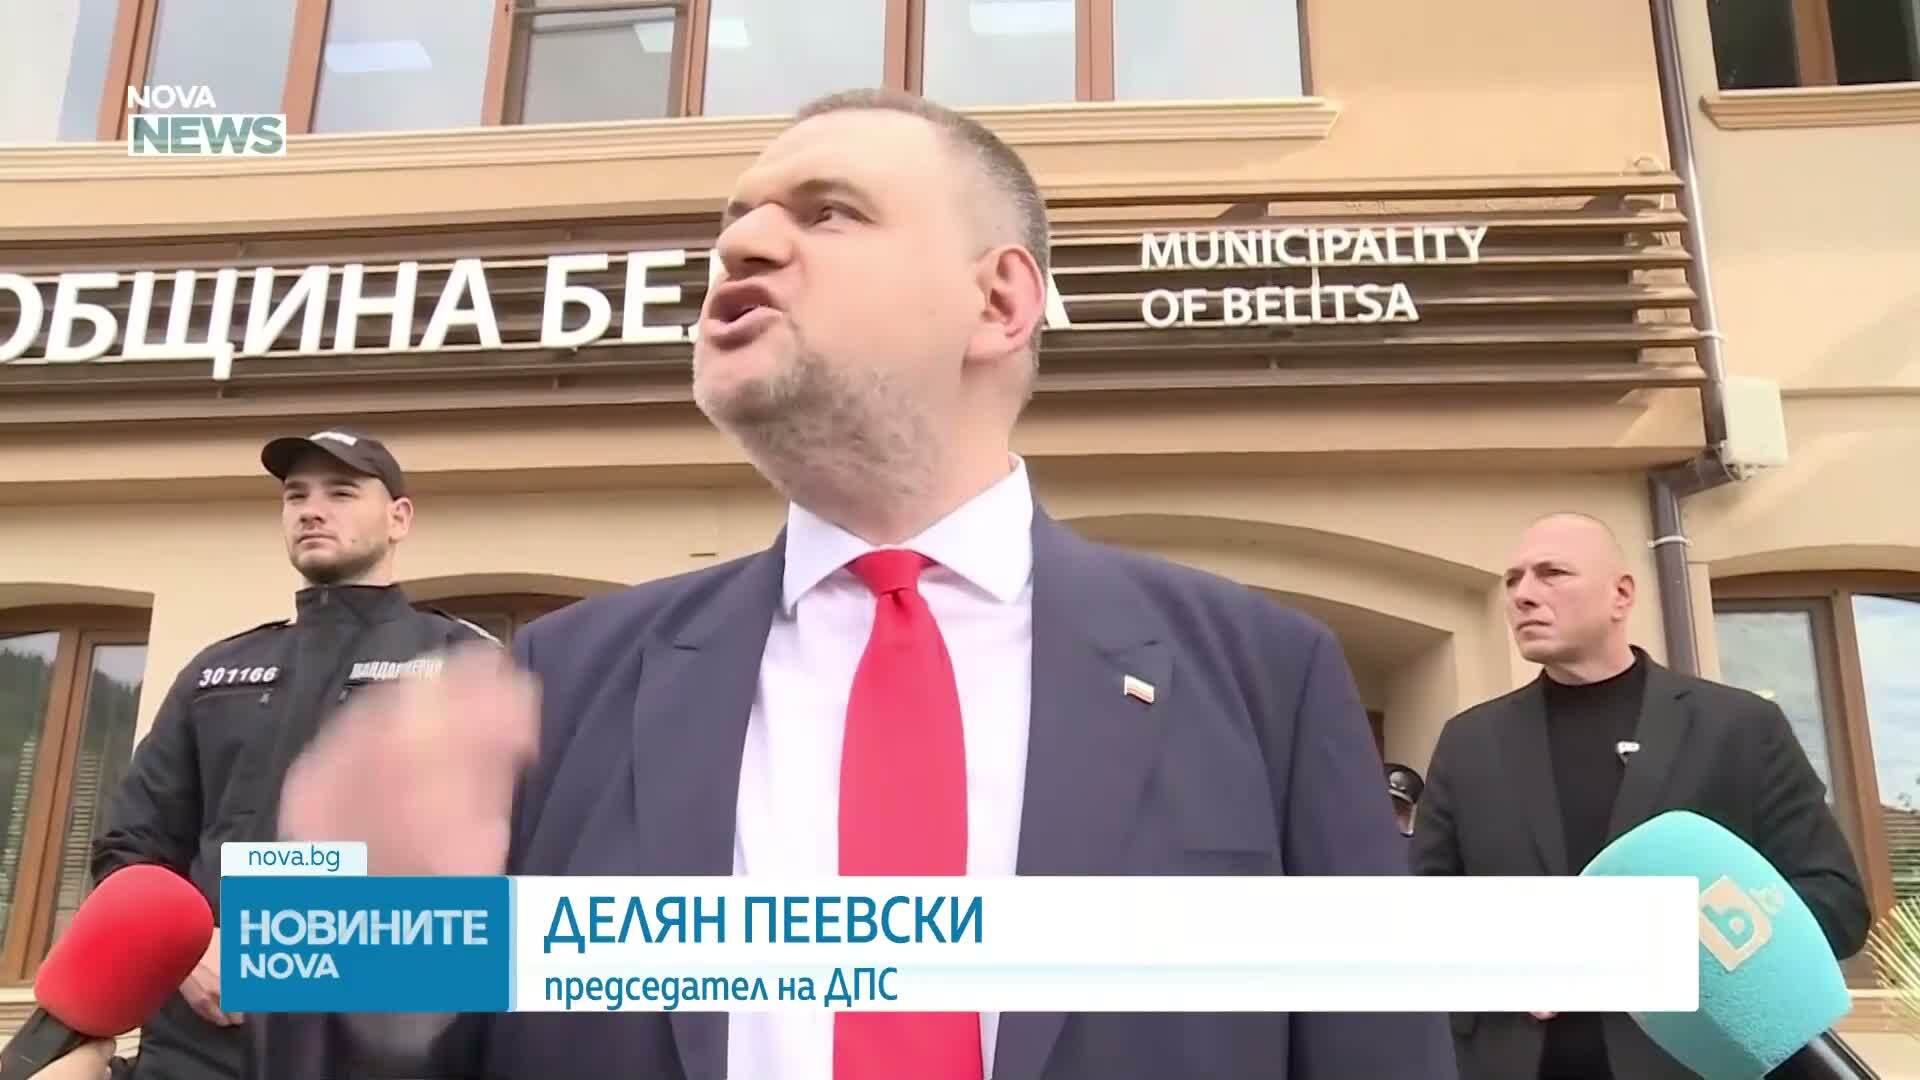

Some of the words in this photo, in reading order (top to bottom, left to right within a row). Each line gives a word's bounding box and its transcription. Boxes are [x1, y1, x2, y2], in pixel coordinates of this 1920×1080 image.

[1141, 224, 1487, 270] MUNICIPALITY
[0, 258, 502, 380] ОБЩИНА
[1142, 288, 1207, 328] OF
[1222, 282, 1419, 326] BELITSA
[198, 666, 279, 688] 301166
